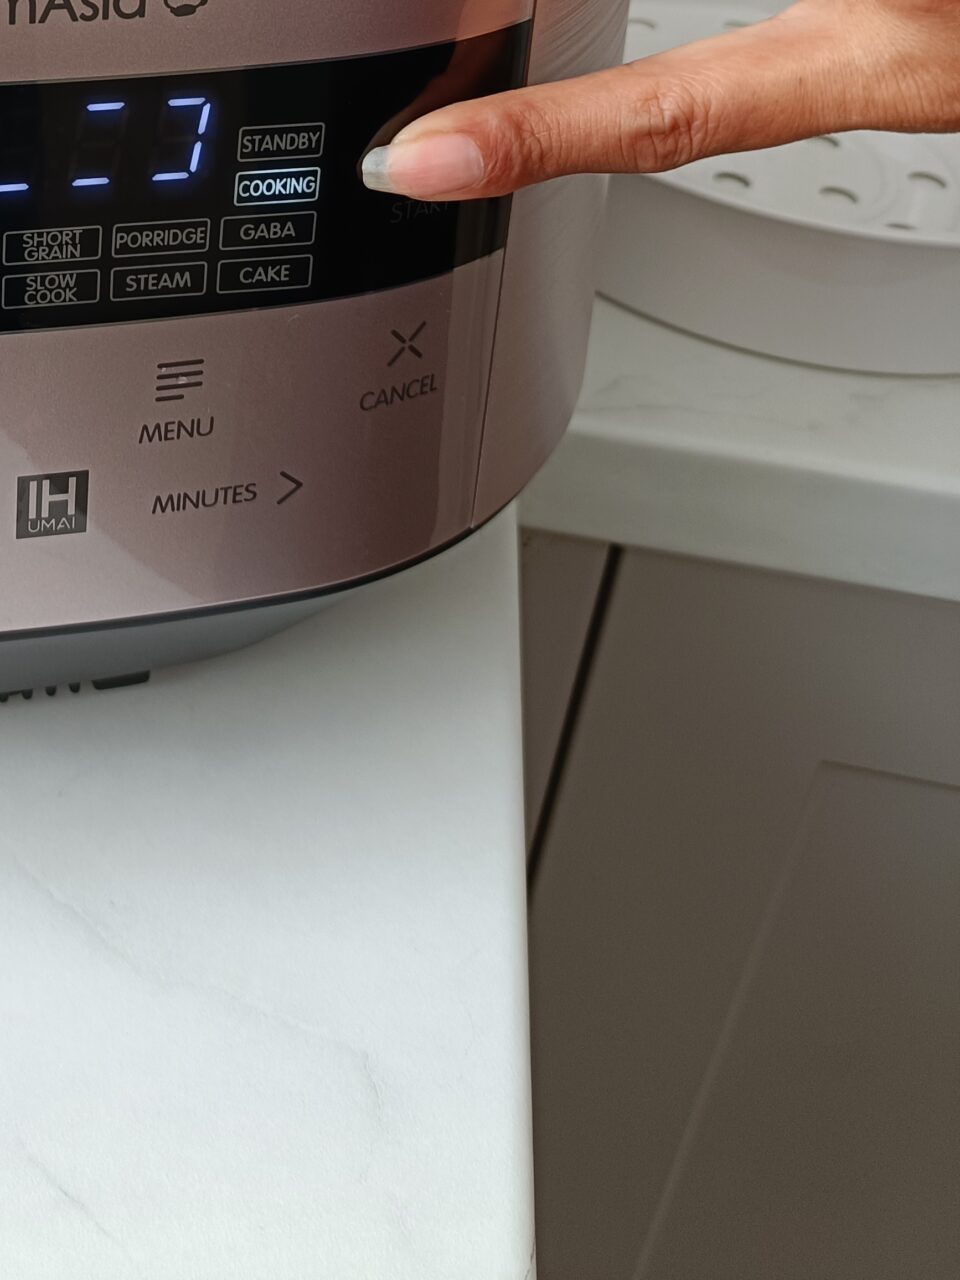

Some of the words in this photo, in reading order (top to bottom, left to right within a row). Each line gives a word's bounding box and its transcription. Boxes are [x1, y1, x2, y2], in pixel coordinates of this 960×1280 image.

[242, 131, 320, 153] STANDBY
[239, 174, 316, 198] COOKING
[22, 229, 83, 248] SHORT
[116, 226, 206, 249] PORRIDGE
[239, 220, 296, 240] GABA
[24, 243, 81, 261] GRAIN
[25, 273, 77, 290] SLOW
[125, 270, 192, 292] STEAM
[239, 264, 290, 284] CAKE
[24, 287, 78, 305] COOK
[359, 373, 438, 411] CANCEL
[138, 416, 215, 444] MENU
[28, 476, 77, 519] IH
[151, 482, 258, 515] MINUTES
[27, 516, 76, 534] UMAI
